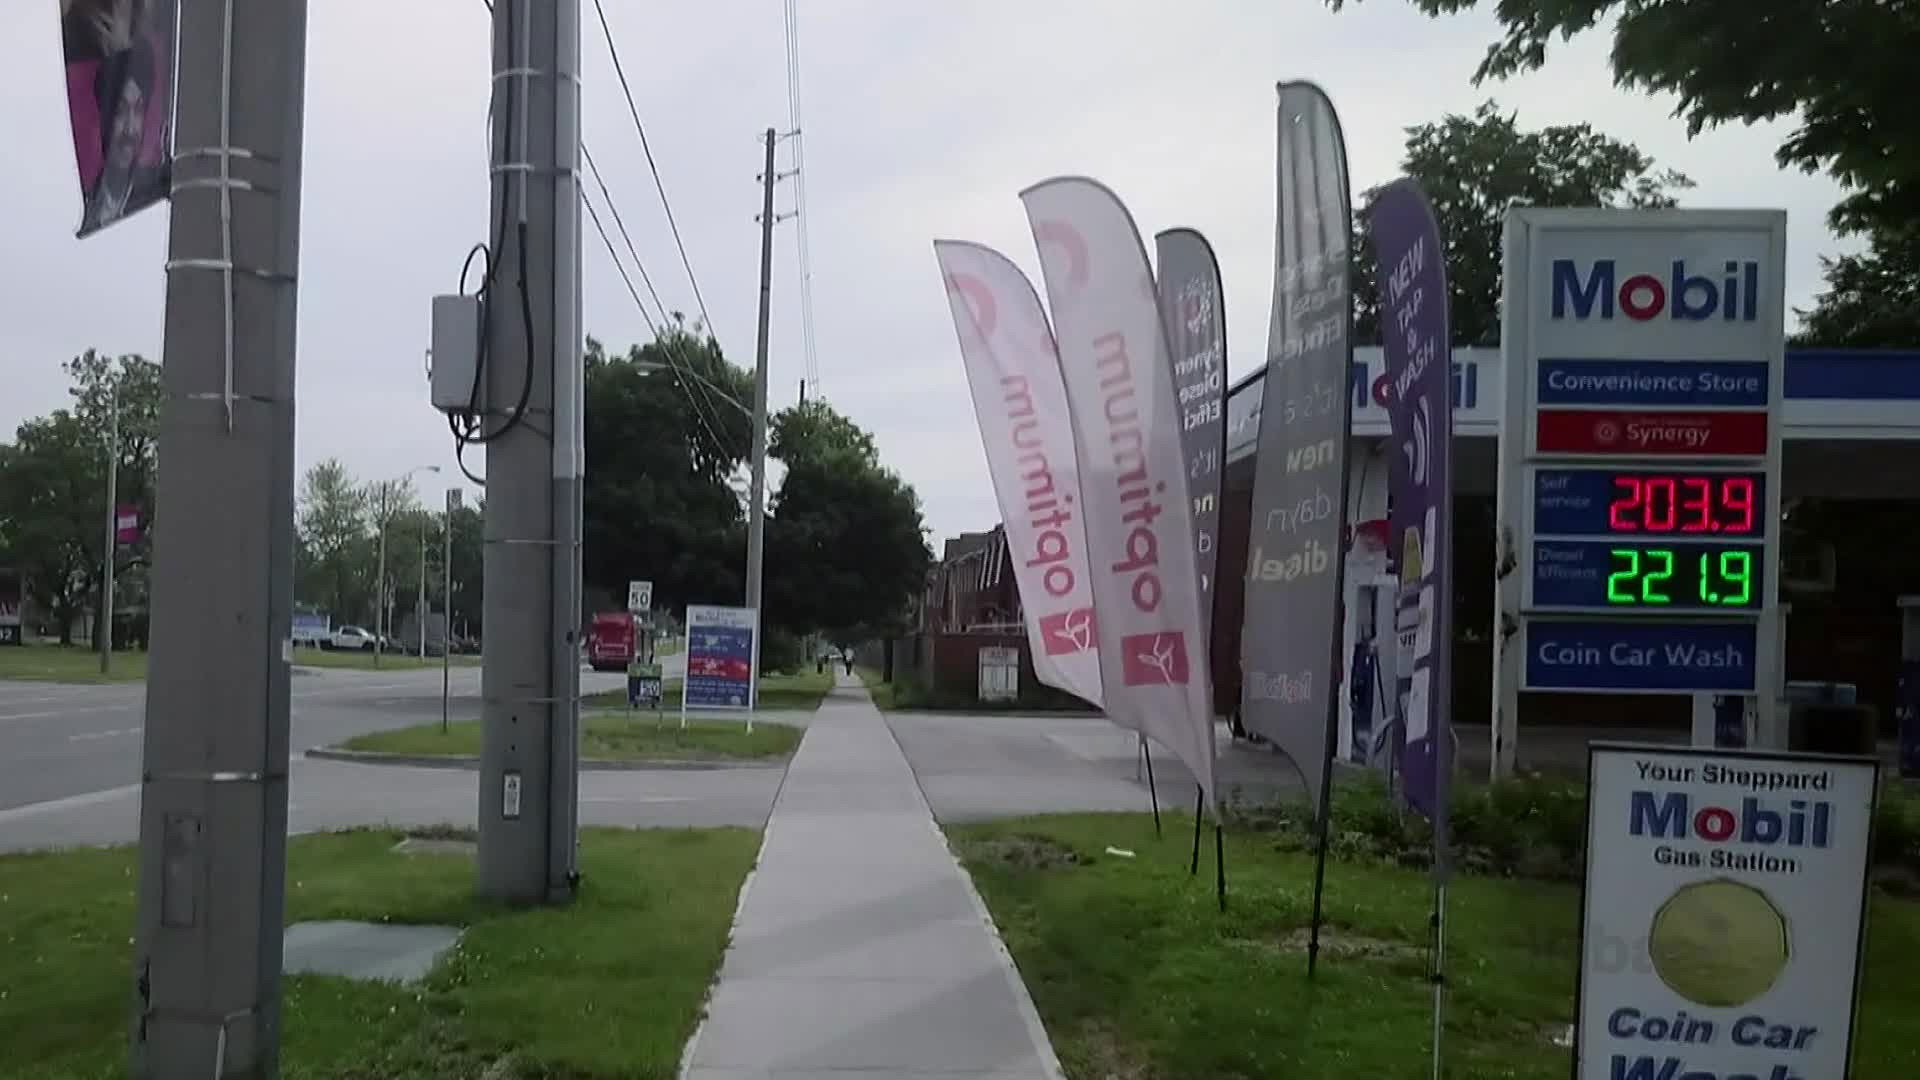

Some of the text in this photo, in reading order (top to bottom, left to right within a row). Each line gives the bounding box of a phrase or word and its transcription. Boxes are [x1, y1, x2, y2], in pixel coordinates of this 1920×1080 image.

[1389, 236, 1424, 305] NEW
[1552, 259, 1758, 321] Mobil
[1398, 288, 1423, 336] TAP
[1395, 336, 1435, 401] WASH
[1548, 370, 1759, 392] Convenience Store
[1627, 423, 1711, 445] Synergy
[1608, 476, 1755, 532] 203.9
[1607, 550, 1751, 604] 221.9
[1538, 642, 1743, 668] Coin Car Wash
[1636, 761, 1828, 792] Your Sheppard
[1629, 790, 1831, 848] Mobil
[1654, 846, 1797, 873] Gas Station
[1608, 1007, 1818, 1050] Coin Car
